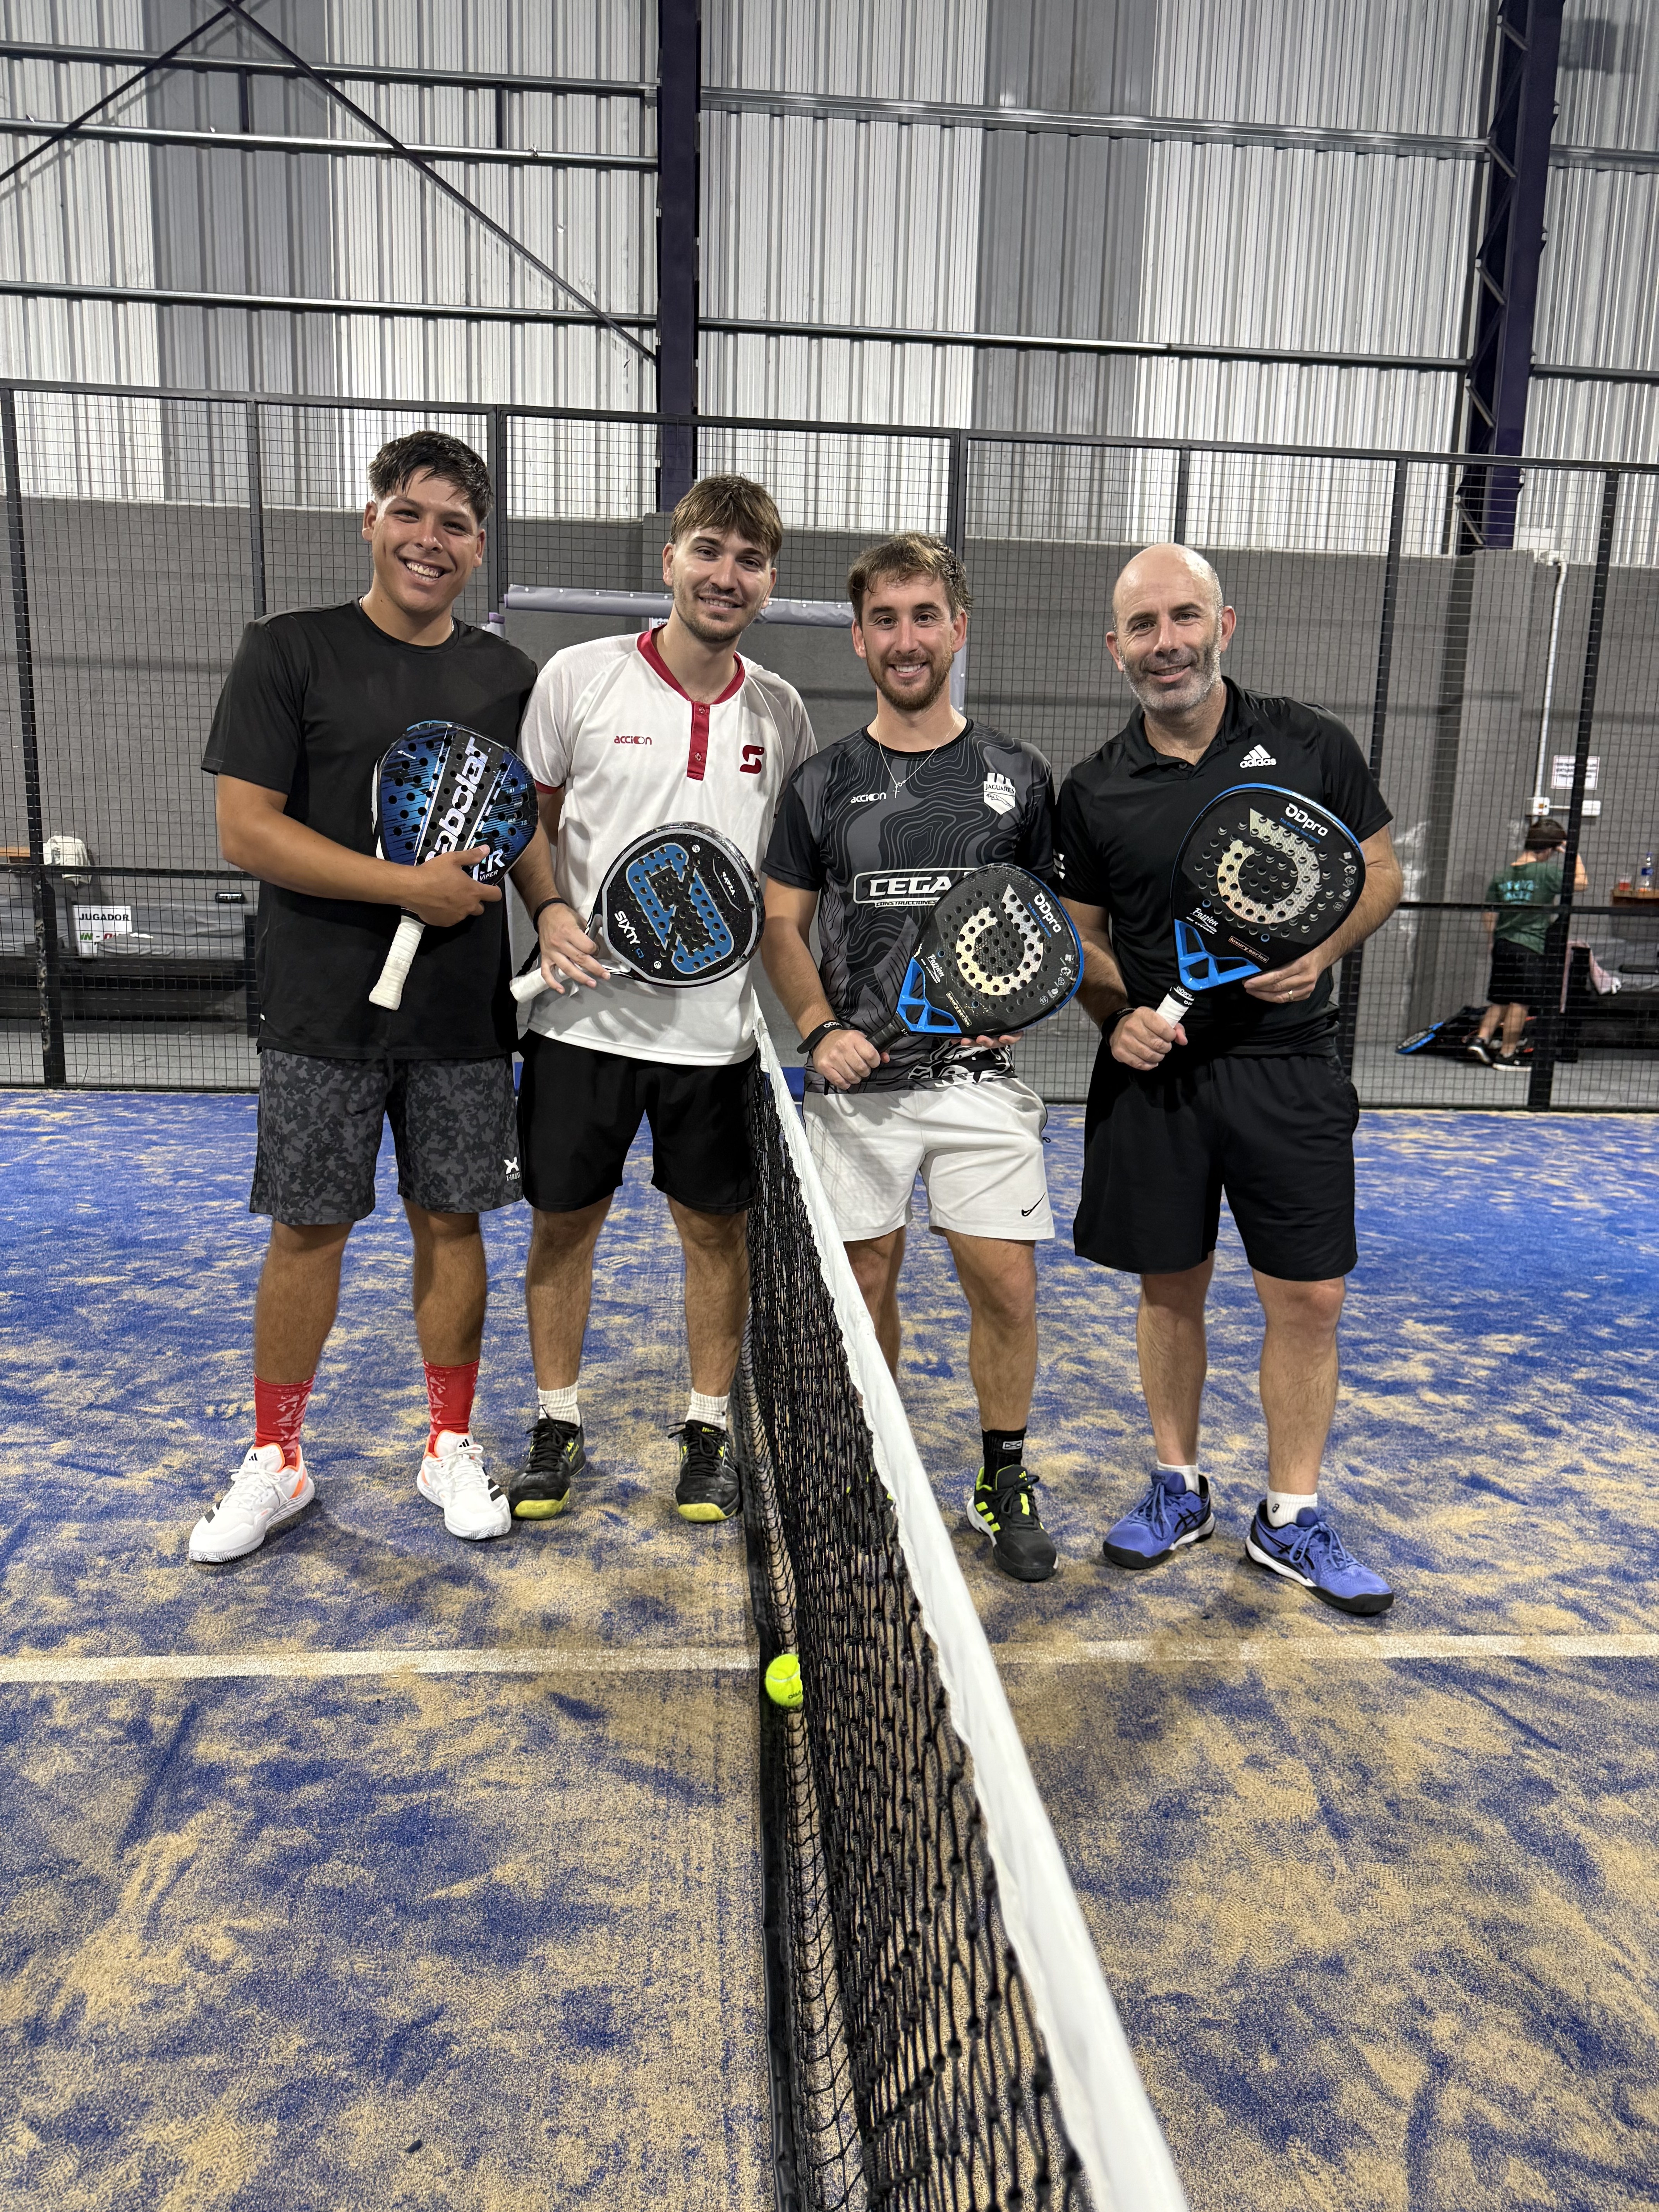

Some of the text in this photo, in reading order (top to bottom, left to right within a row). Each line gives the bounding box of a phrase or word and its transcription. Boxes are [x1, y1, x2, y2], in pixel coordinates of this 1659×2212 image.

[1240, 757, 1277, 769] adidas
[985, 784, 1014, 794] JAGUARES
[480, 870, 498, 881] VIPER
[1192, 907, 1219, 927] Passion
[614, 910, 641, 944] SIXTY
[927, 954, 945, 977] Passion
